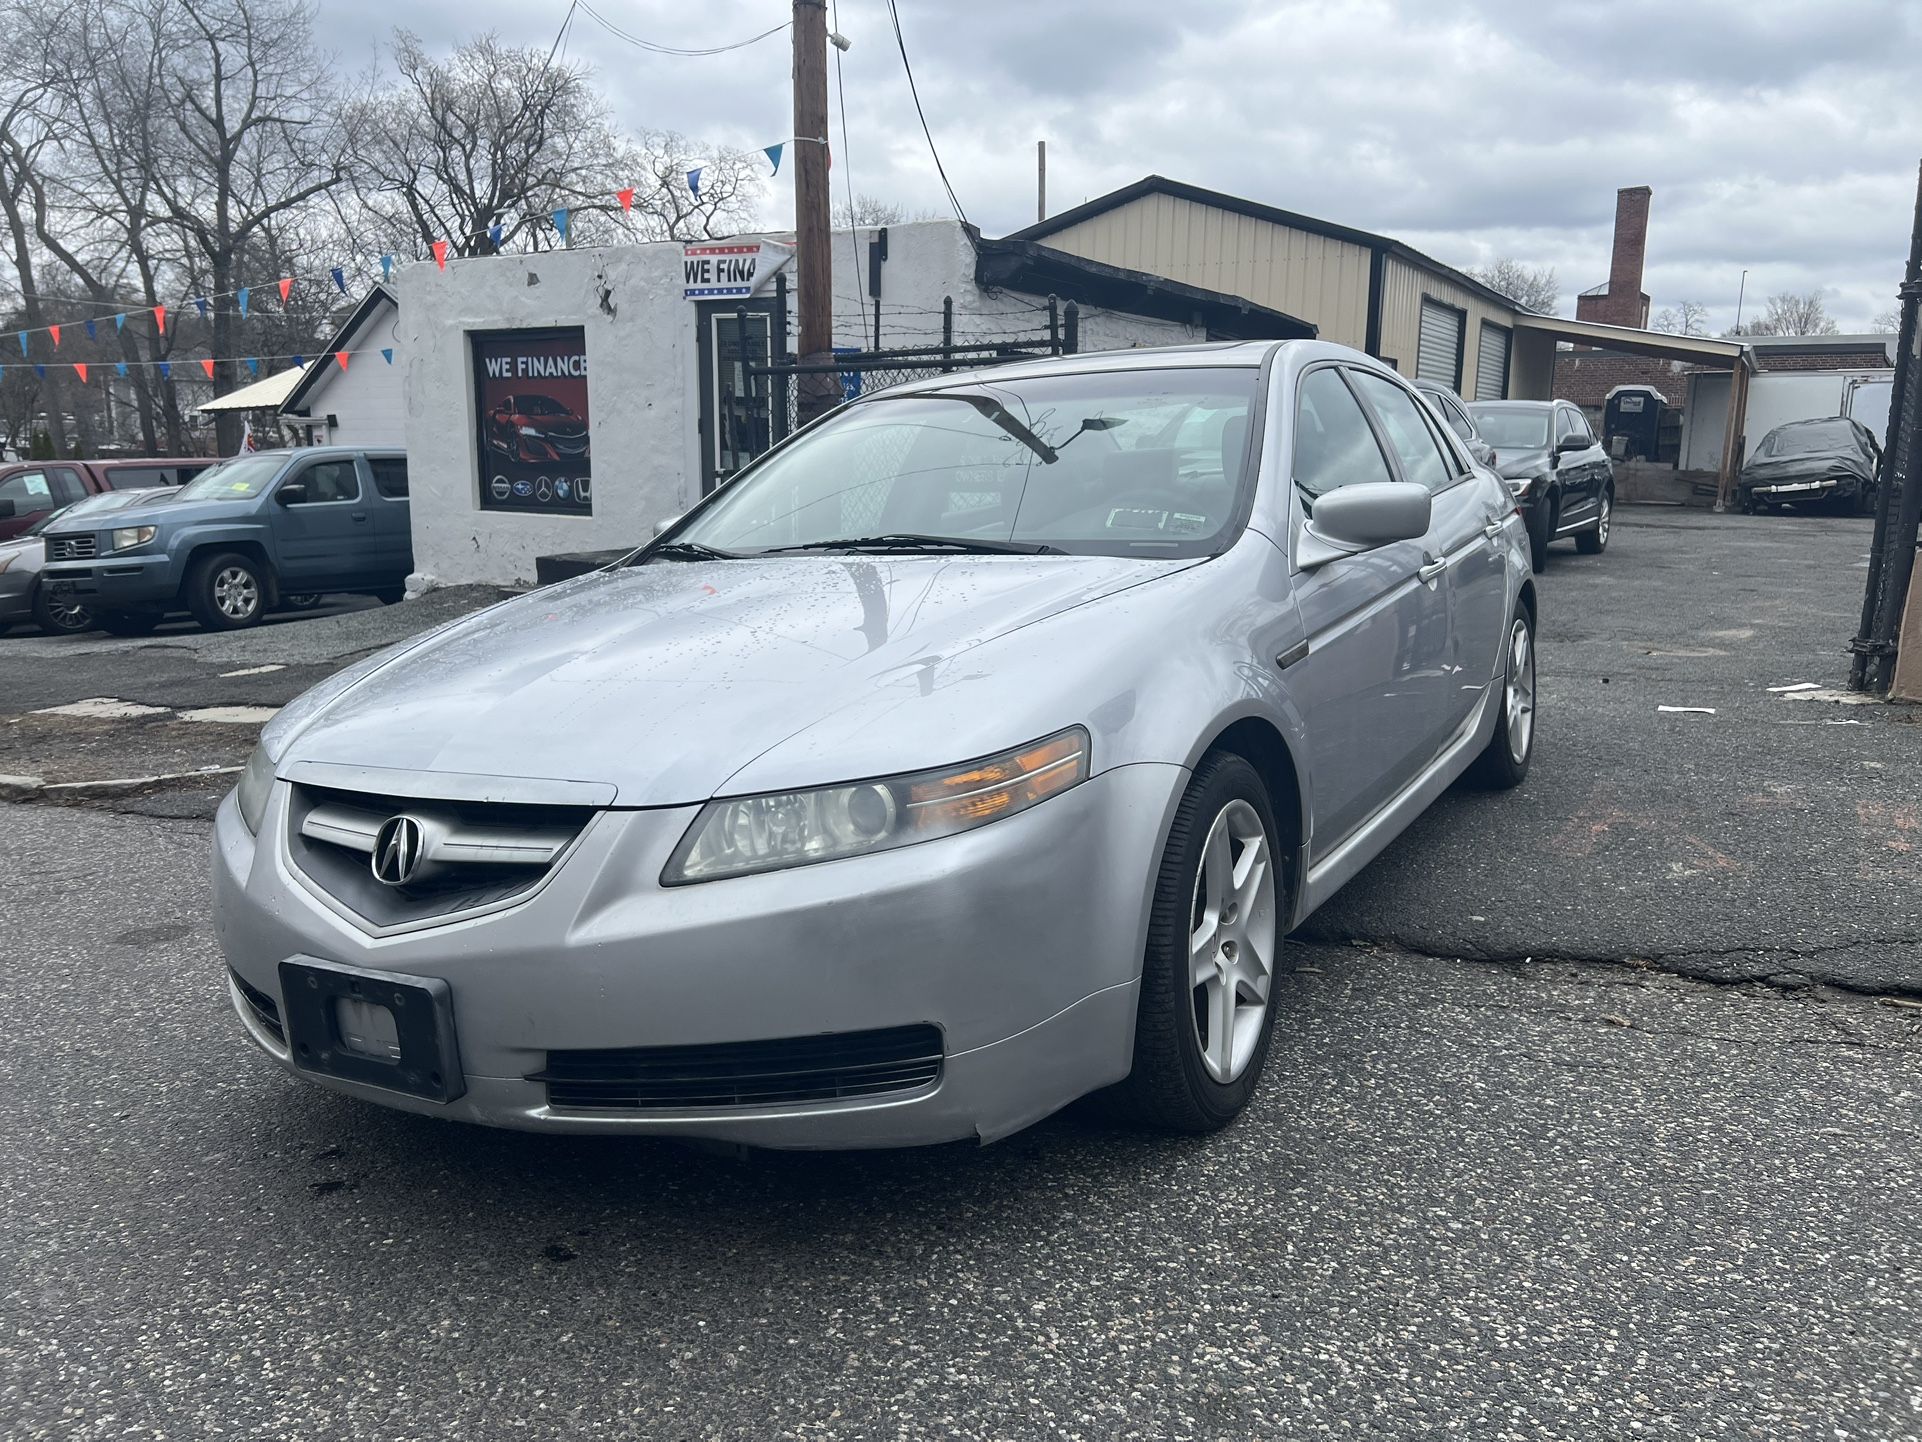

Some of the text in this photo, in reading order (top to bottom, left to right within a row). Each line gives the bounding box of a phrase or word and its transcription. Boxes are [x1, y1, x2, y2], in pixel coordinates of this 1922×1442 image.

[684, 258, 756, 284] WE FINA
[485, 355, 587, 377] WE FINANCE
